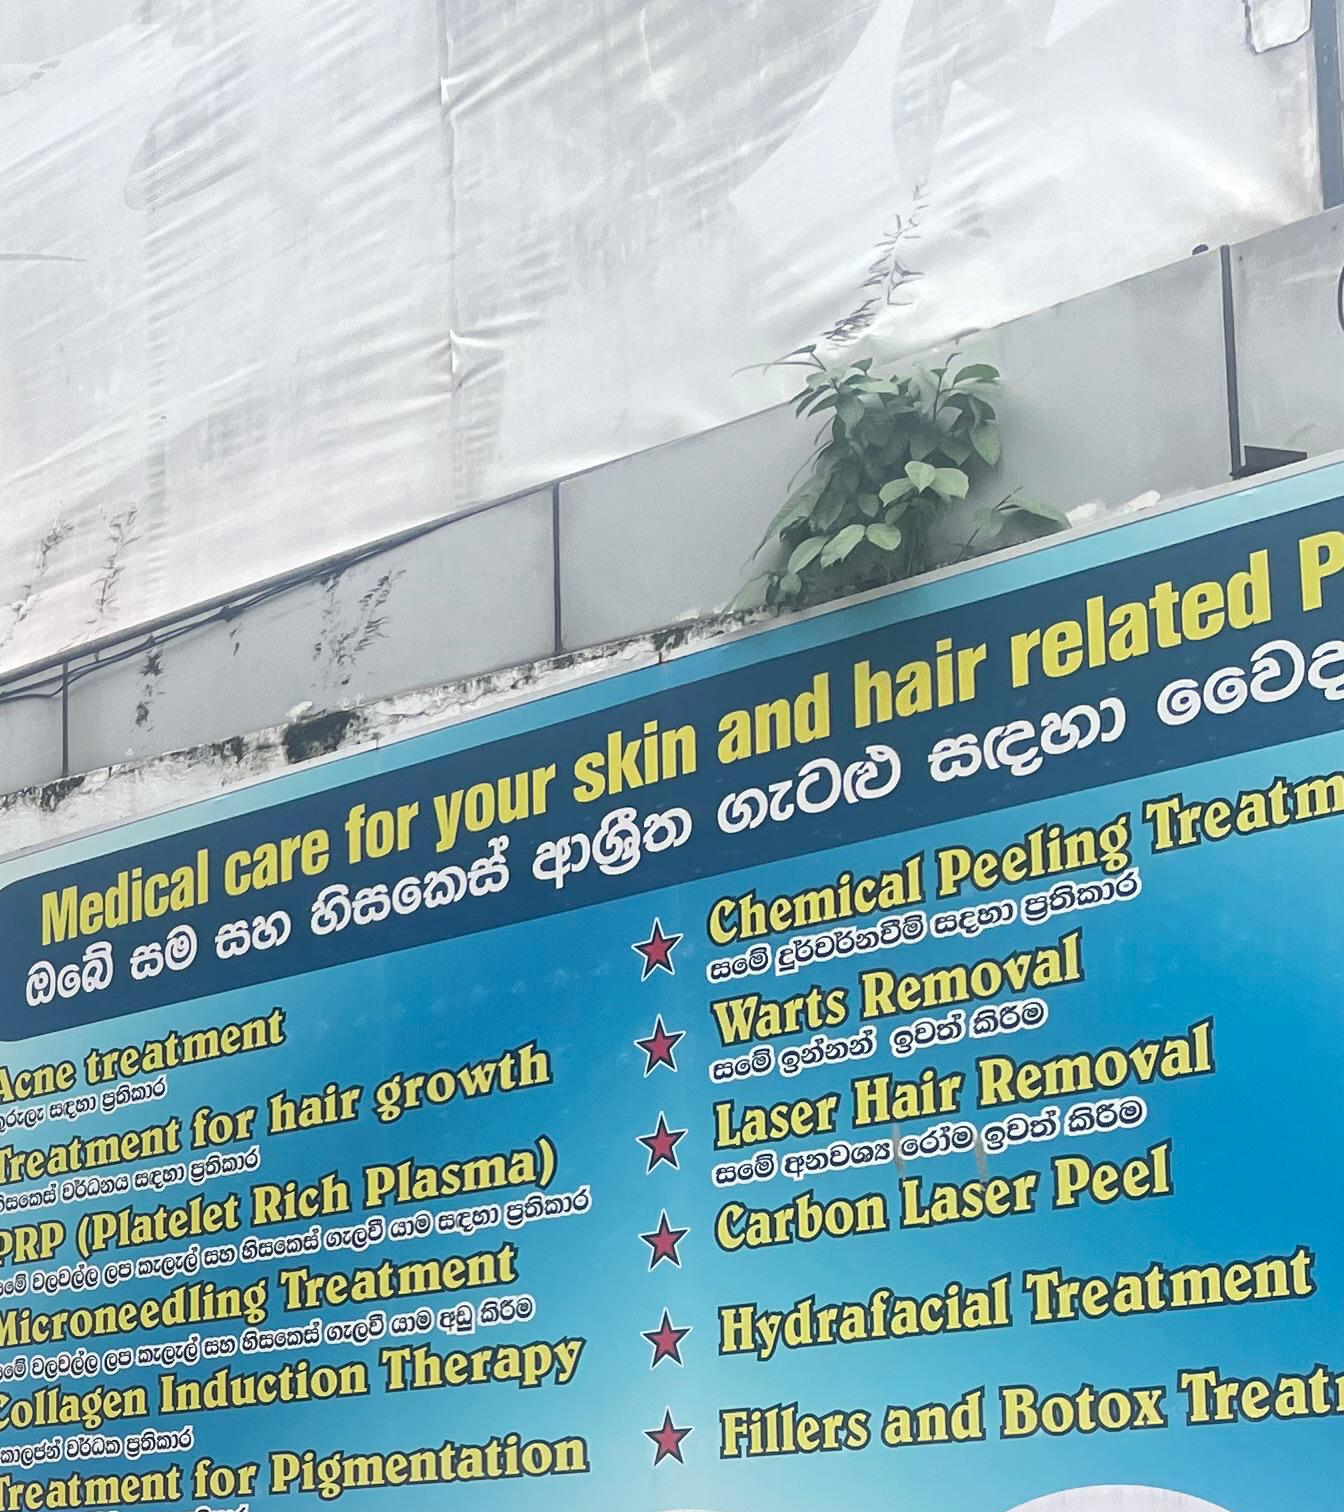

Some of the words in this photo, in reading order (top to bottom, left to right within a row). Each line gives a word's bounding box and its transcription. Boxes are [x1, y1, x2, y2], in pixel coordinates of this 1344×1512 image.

[41, 851, 208, 946] Medical
[224, 829, 329, 898] care
[345, 797, 418, 861] for
[435, 764, 556, 846] your
[573, 721, 697, 803] skin
[718, 673, 831, 763] and
[853, 640, 987, 729] hair
[1011, 549, 1272, 688] related
[26, 942, 114, 1007] ඔබේ
[131, 927, 197, 981] සම
[215, 907, 291, 961] සහ
[311, 836, 510, 935] හිසකෙස්
[717, 745, 902, 835] ගැටළු
[928, 697, 1127, 777] සඳහා
[708, 857, 923, 945] Chemical
[936, 815, 1129, 894] Peeling
[710, 950, 769, 980] සමේ
[713, 987, 848, 1045] Warts
[861, 930, 1083, 1019] Removal
[85, 1010, 286, 1084] treatment
[192, 1107, 256, 1148] for
[270, 1083, 362, 1135] hair
[376, 1041, 551, 1121] growth
[713, 1050, 771, 1080] සමේ
[894, 1014, 962, 1052] ඉවත්
[715, 1094, 838, 1148] Laser
[853, 1070, 962, 1127] Hair
[978, 1020, 1214, 1104] Removal
[77, 1194, 240, 1258] (Platelet
[253, 1171, 350, 1226] Rich
[364, 1136, 556, 1208] Plasma)
[715, 1192, 886, 1252] Carbon
[899, 1173, 1036, 1229] Laser
[1053, 1140, 1172, 1207] Peel
[716, 1154, 774, 1185] සමේ
[984, 1111, 1057, 1149] ඉවත්
[279, 1244, 517, 1310] Treatment
[719, 1277, 1009, 1360] Hydrafacial
[1023, 1248, 1312, 1320] Treatment
[159, 1361, 368, 1414] Induction
[381, 1337, 584, 1390] Therapy
[720, 1403, 868, 1458] Fillers
[881, 1389, 984, 1446] and
[1002, 1386, 1165, 1436] Botox
[1180, 1367, 1344, 1423] Treat
[193, 1459, 258, 1498] for
[271, 1433, 588, 1499] Pigmentation
